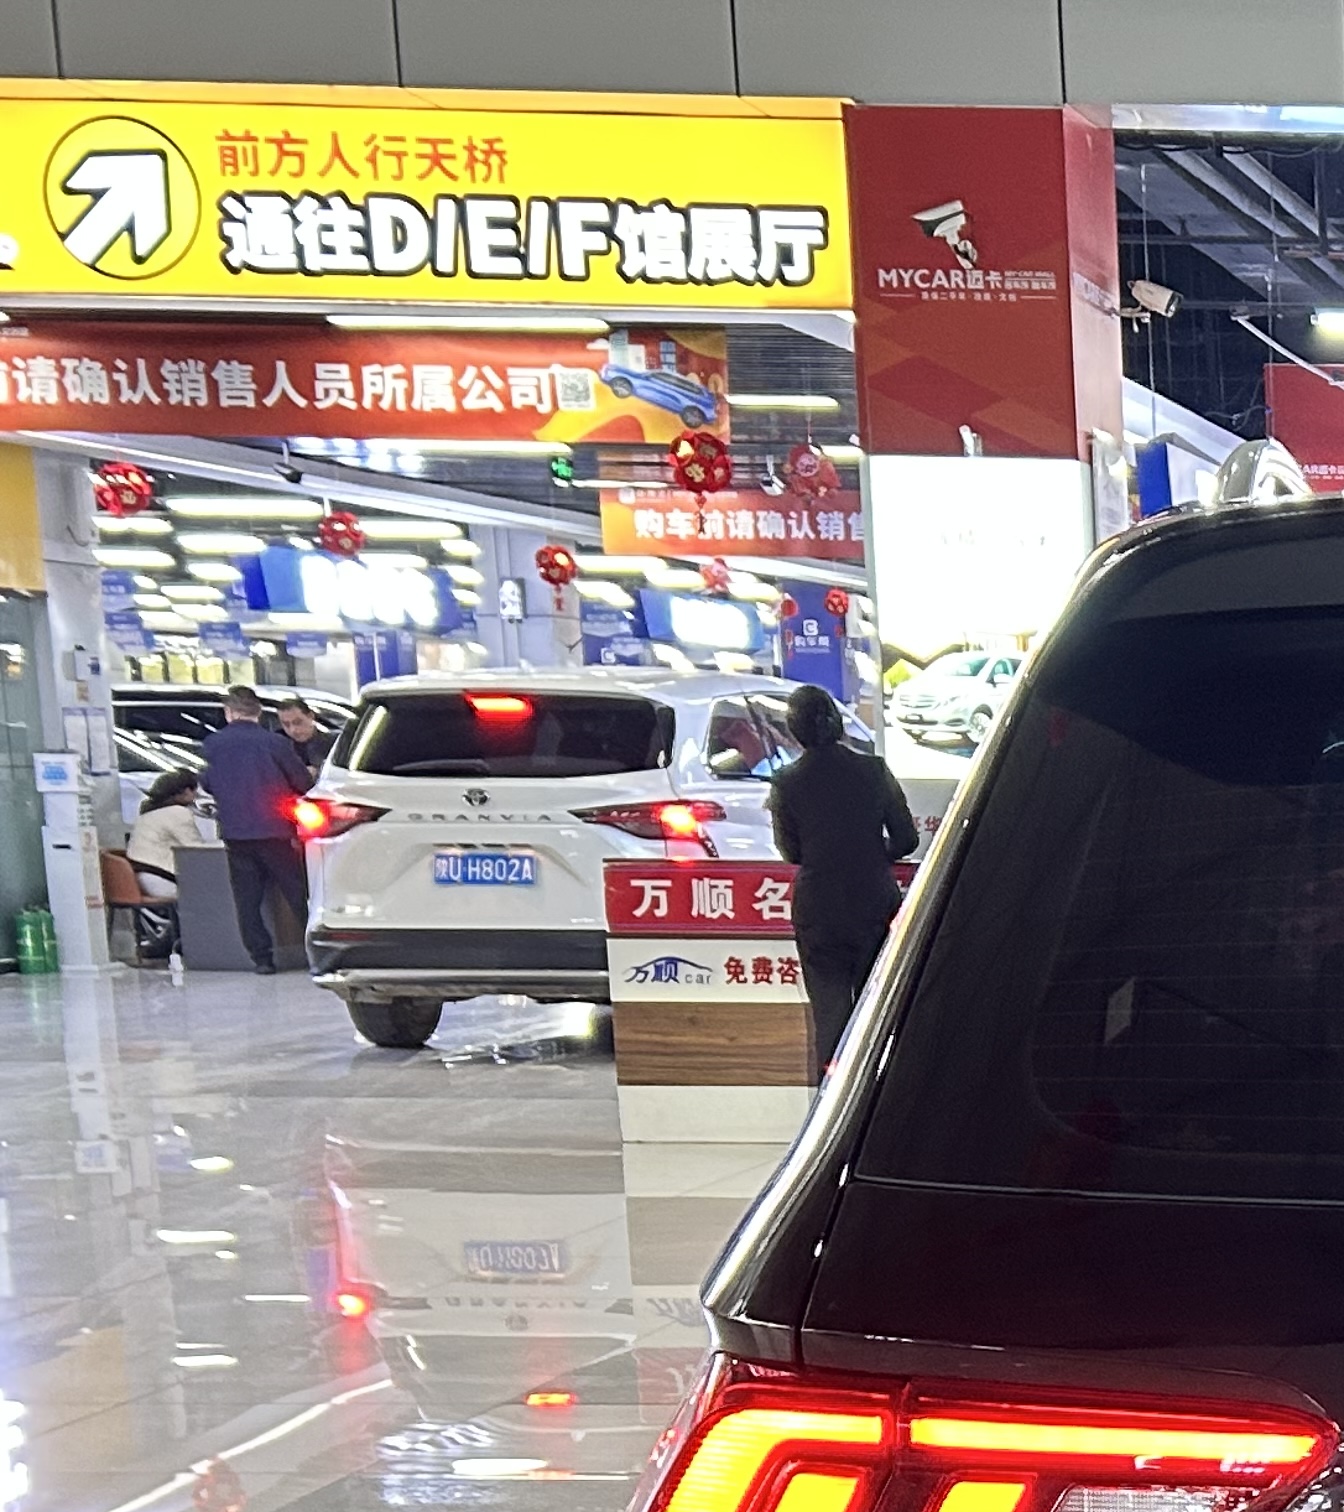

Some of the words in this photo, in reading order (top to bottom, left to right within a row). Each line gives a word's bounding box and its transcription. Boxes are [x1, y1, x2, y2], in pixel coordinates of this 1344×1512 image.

[215, 129, 509, 183] 前方人行天桥
[0, 356, 551, 414] 请确认销售人员所属公司
